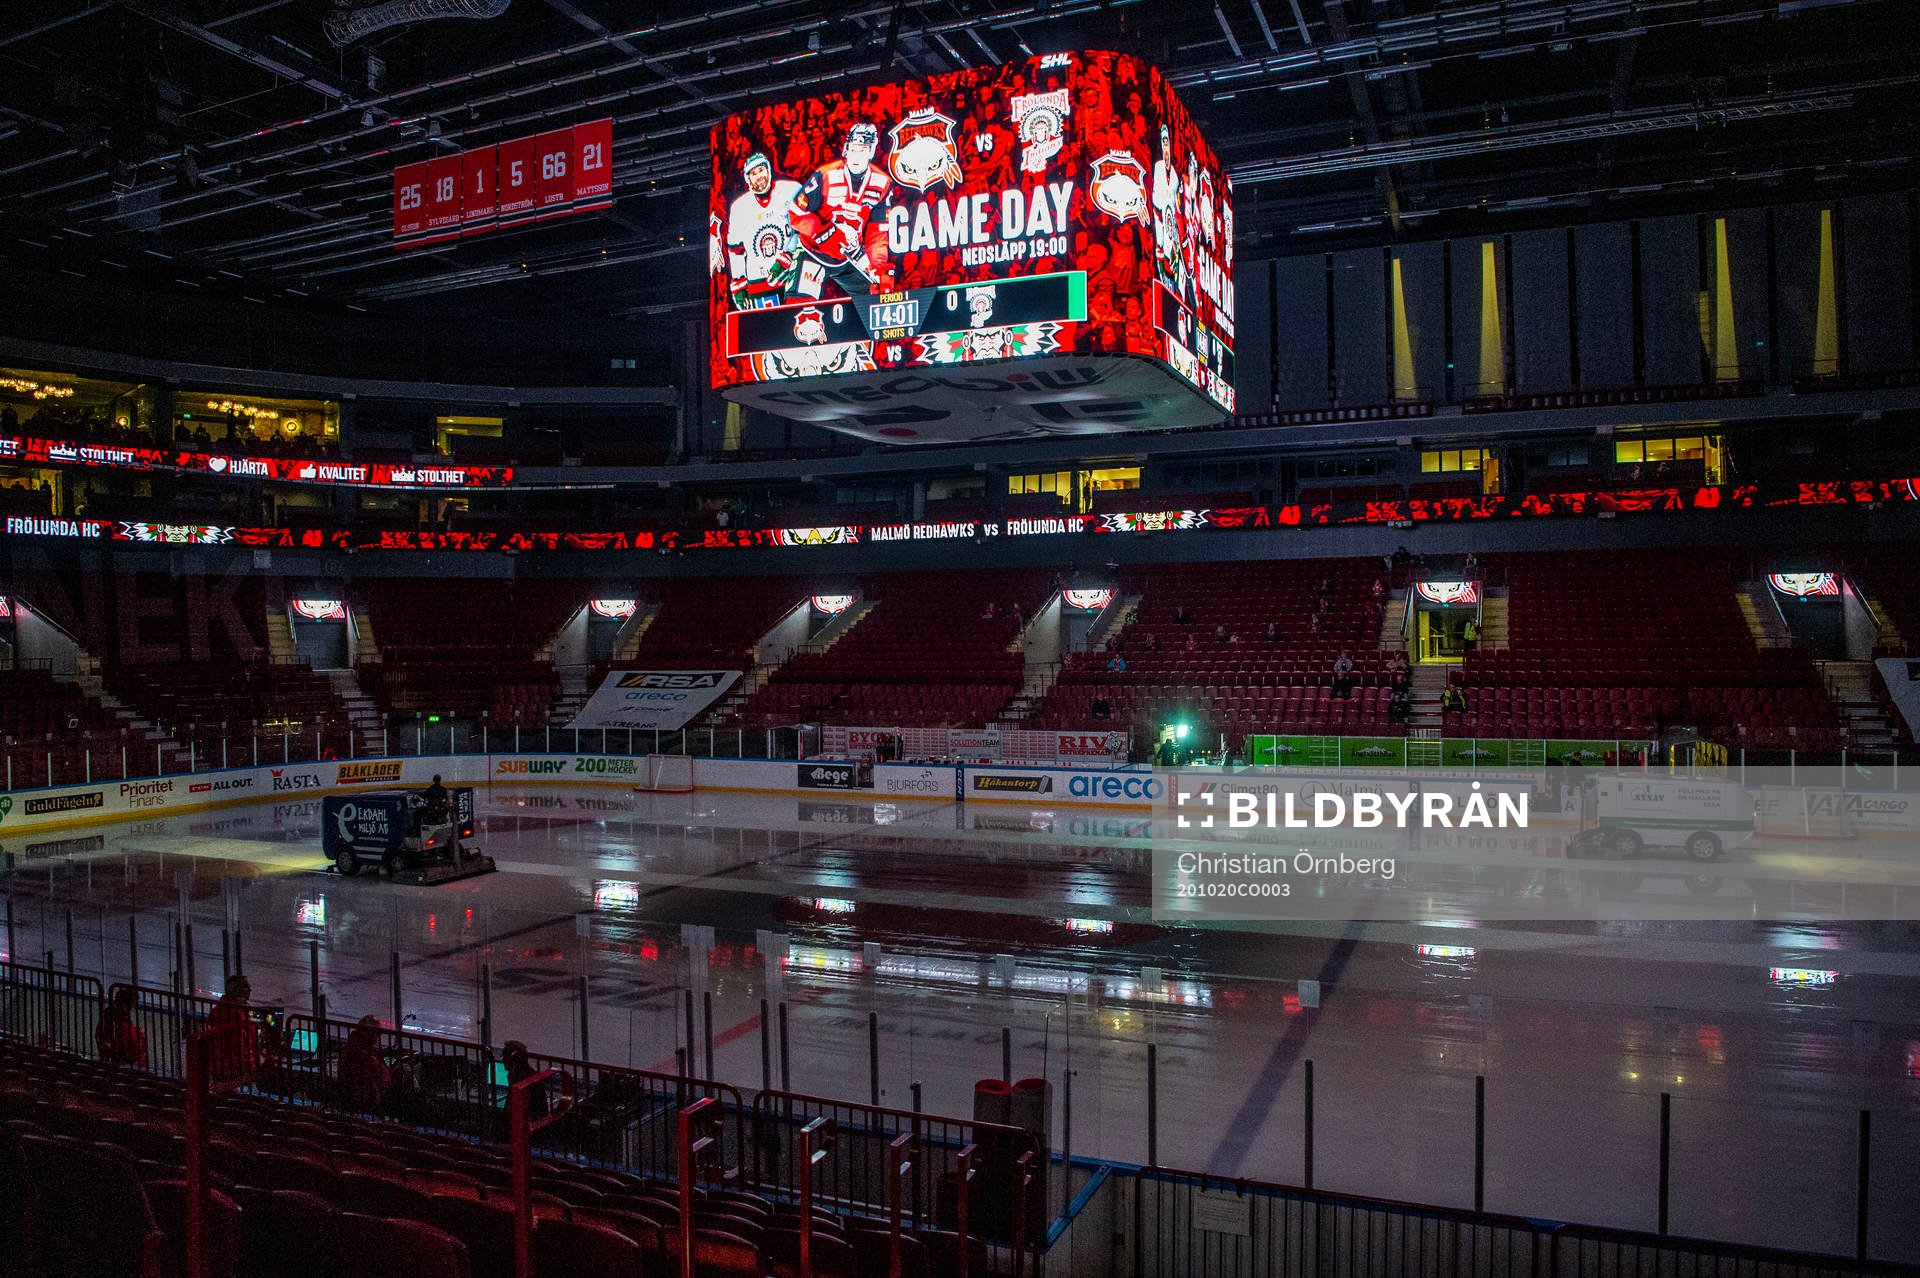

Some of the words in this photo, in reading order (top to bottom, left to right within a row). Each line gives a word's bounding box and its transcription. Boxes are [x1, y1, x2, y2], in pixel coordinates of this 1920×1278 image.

[1040, 53, 1073, 69] SHL
[899, 122, 946, 146] REDHAWKS
[976, 133, 993, 152] VS
[583, 142, 603, 171] 21
[511, 160, 523, 187] 5
[543, 151, 566, 180] 66
[435, 176, 455, 203] 18
[476, 168, 484, 194] 1
[400, 184, 421, 210] 25
[576, 183, 609, 197] MATTSSON
[889, 193, 990, 254] GAME
[1002, 182, 1074, 239] DAY
[962, 241, 1027, 267] NEDSLÄPP
[1029, 236, 1068, 259] 19:00
[880, 293, 903, 304] PERIOD
[905, 291, 909, 301] 1
[946, 290, 959, 311] 0
[833, 304, 844, 323] 0
[873, 304, 914, 327] 14:01
[875, 330, 880, 340] 0
[882, 327, 905, 339] SHOTS
[908, 326, 914, 337] 0
[887, 344, 902, 363] VS
[230, 459, 268, 476] HJÄRTA
[319, 465, 366, 482] KVALITET
[417, 469, 465, 484] STOLTHET
[7, 517, 79, 537] FRÖLUNDA
[82, 522, 101, 538] HC
[872, 525, 911, 541] MALMÖ
[913, 523, 975, 539] REDHAWKS
[984, 524, 999, 537] VS
[1007, 518, 1065, 535] FRÖLUNDA
[1068, 518, 1084, 533] HC
[643, 675, 716, 688] RSA
[625, 692, 688, 701] areco
[496, 760, 567, 774] SUBWAY
[575, 757, 606, 773] 200
[608, 759, 634, 767] METER
[608, 766, 638, 775] HOCKEY
[273, 774, 321, 791] RASTA
[812, 767, 849, 784] Bege
[978, 777, 1038, 790] Håkantorp
[120, 780, 173, 797] Prioritet
[213, 781, 231, 791] ALL
[887, 779, 939, 792] BJURFORS
[1068, 775, 1163, 799] areco
[129, 795, 164, 809] Finans
[1864, 800, 1909, 810] CARGO
[358, 807, 389, 822] EKDAHL
